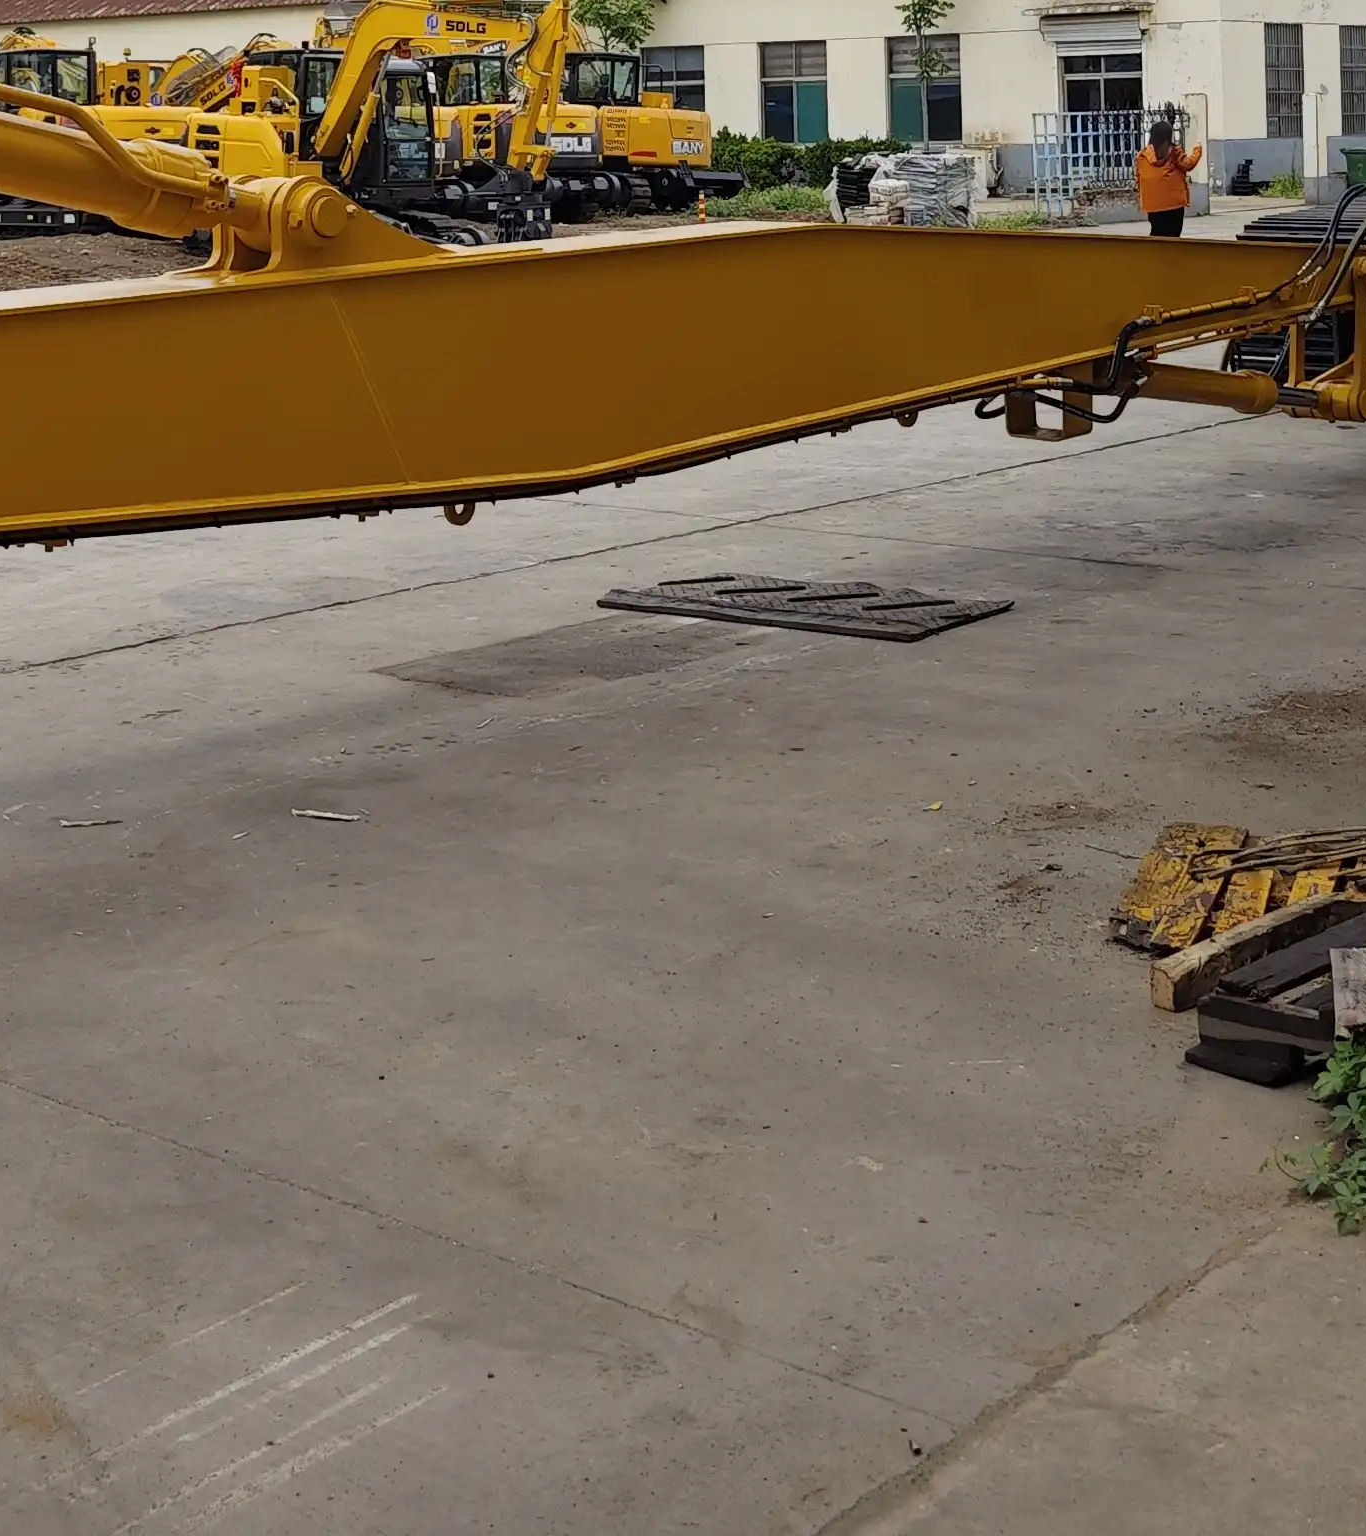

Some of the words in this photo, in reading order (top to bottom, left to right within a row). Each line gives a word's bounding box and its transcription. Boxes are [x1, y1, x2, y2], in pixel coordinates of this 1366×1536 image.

[445, 19, 487, 35] SDLG
[199, 80, 227, 107] SDLG
[549, 136, 593, 153] SDLG
[672, 140, 705, 155] SANY
